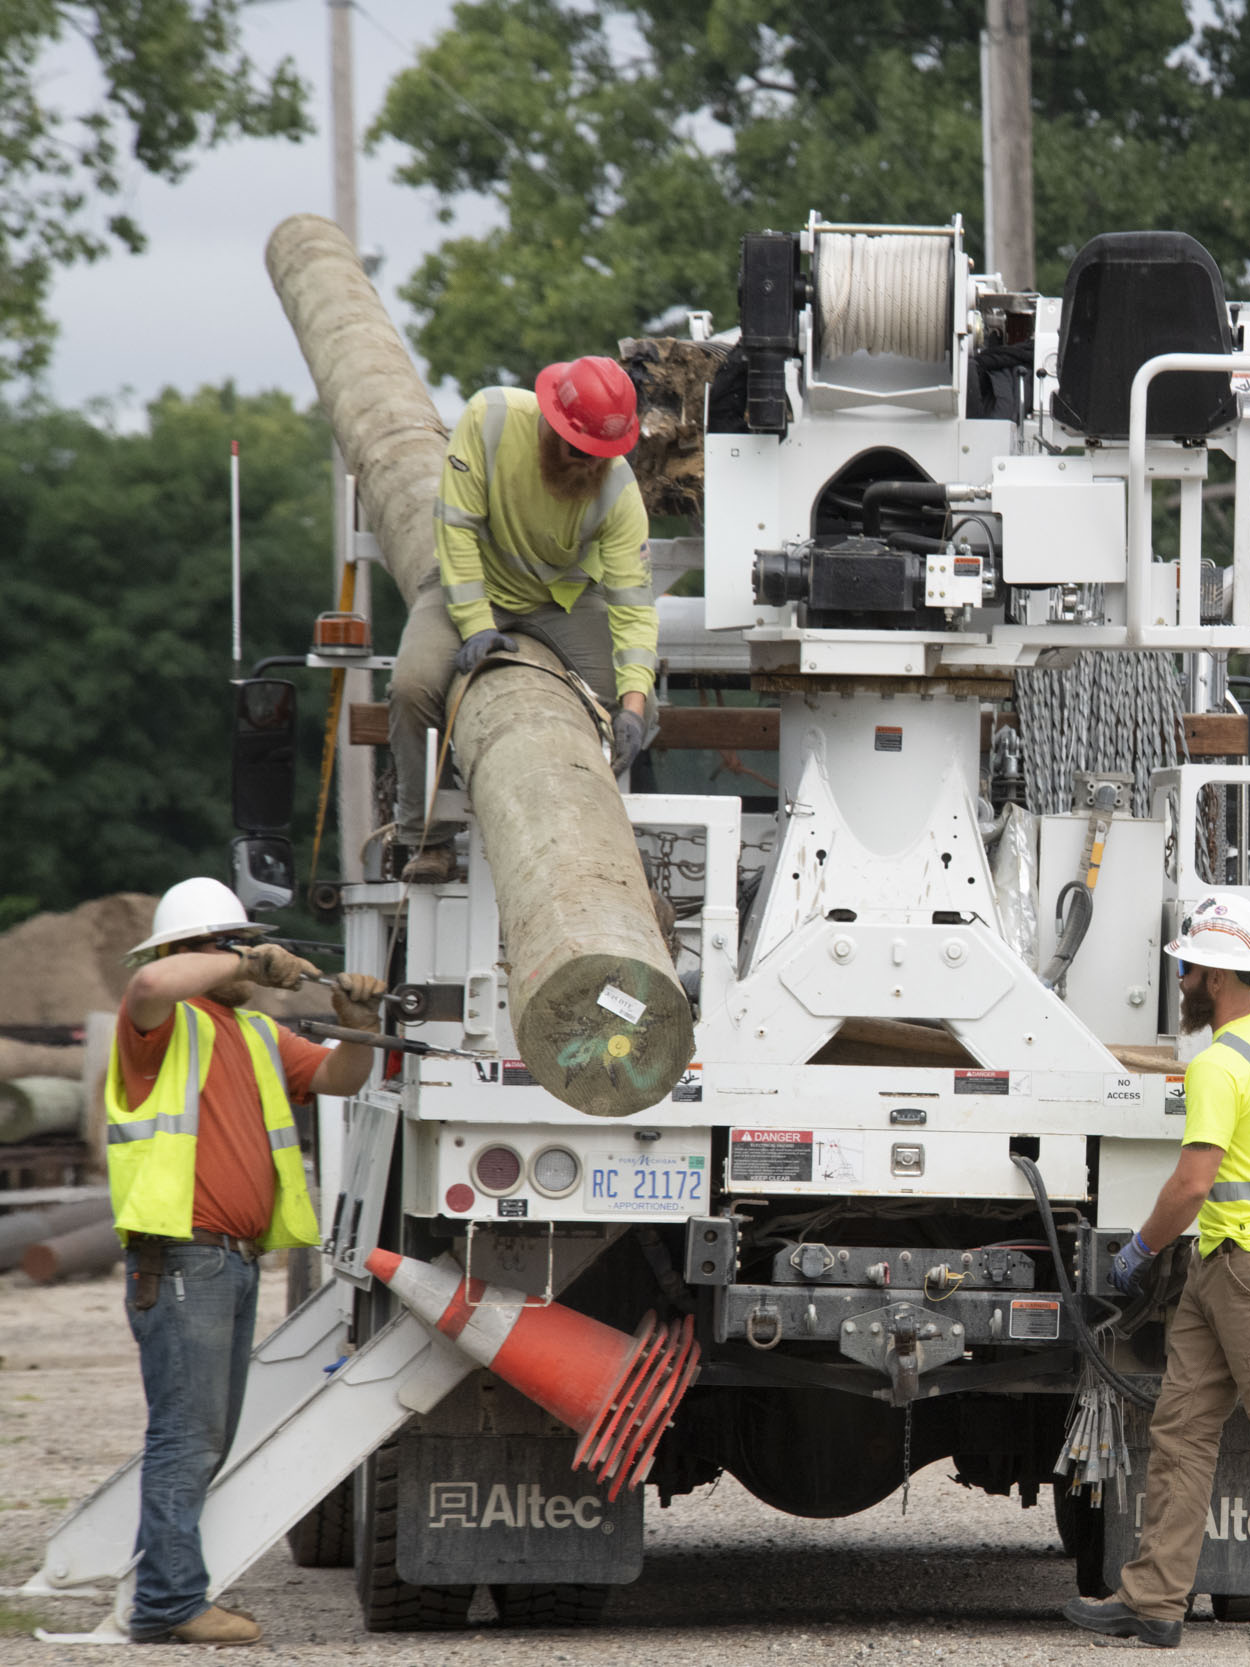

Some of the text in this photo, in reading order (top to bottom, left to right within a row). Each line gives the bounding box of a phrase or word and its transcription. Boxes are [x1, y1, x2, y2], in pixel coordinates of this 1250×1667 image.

[1118, 1079, 1131, 1087] NO
[1107, 1092, 1141, 1100] ACCESS
[754, 1132, 801, 1142] DANGER
[593, 1169, 701, 1200] RC 21172
[613, 1201, 679, 1211] APPORTIONED
[480, 1483, 602, 1529] Altec
